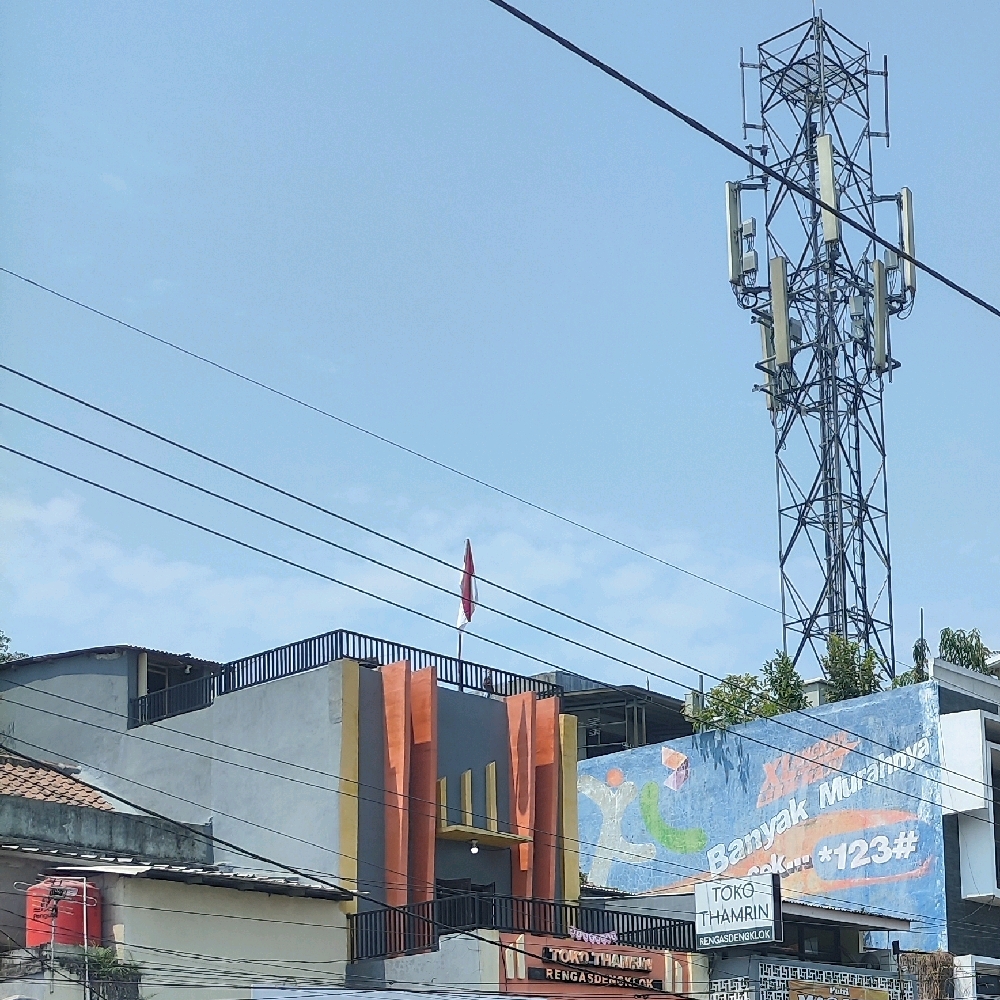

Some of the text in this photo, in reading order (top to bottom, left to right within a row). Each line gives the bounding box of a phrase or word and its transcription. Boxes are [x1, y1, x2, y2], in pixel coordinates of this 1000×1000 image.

[706, 797, 809, 879] Banyak
[819, 735, 932, 809] Murahnya
[711, 882, 754, 902] TOKO
[701, 903, 769, 926] THAMRIN
[699, 929, 771, 946] RENGASDENGKLOK
[549, 948, 653, 970] TOKO THAMRIN
